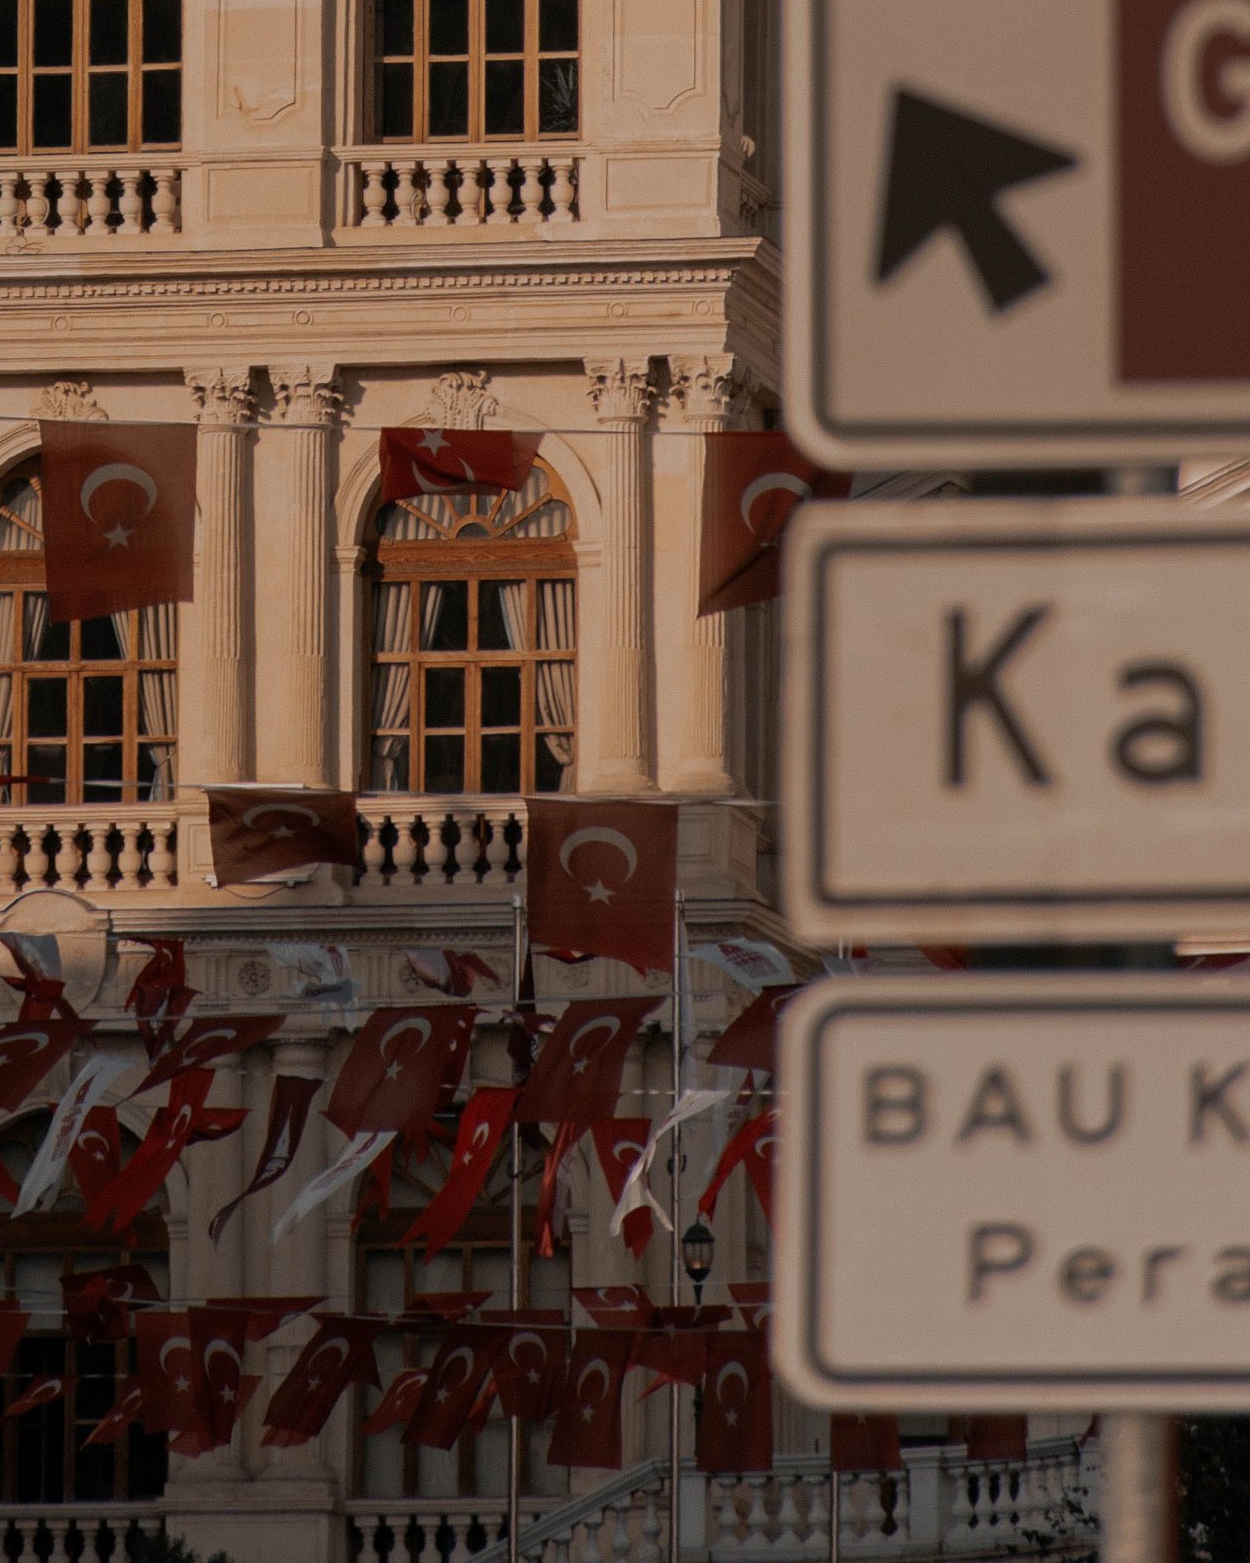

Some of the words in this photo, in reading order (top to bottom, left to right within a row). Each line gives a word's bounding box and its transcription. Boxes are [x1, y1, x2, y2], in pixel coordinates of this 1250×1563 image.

[944, 605, 1206, 790] Ka
[863, 1063, 1127, 1145] BAU
[1190, 1063, 1250, 1144] K
[967, 1221, 1250, 1306] Pera
